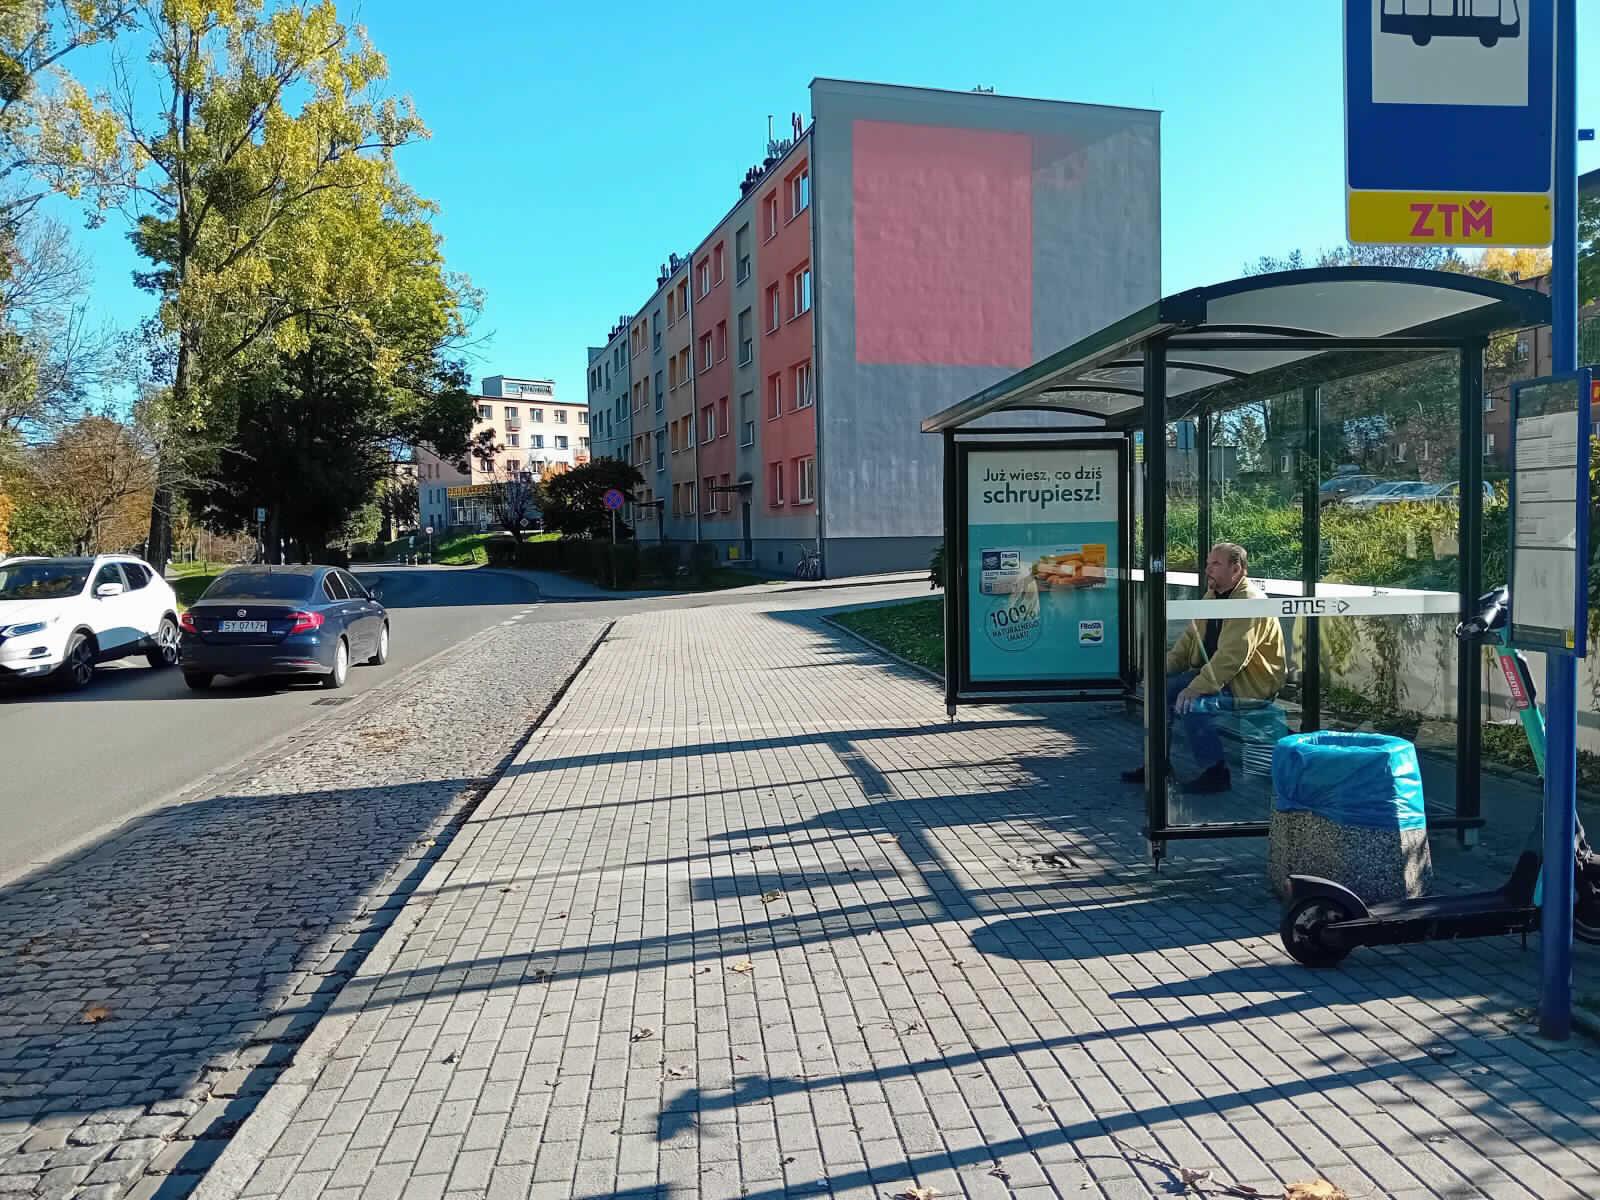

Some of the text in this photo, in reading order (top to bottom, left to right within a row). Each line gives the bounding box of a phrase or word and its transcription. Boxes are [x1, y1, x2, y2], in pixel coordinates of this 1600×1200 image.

[1410, 201, 1492, 238] ZTM
[984, 466, 1103, 482] Już wiesz, co dziś
[983, 481, 1101, 509] schrupiesz!
[990, 604, 1036, 629] 100%
[1281, 600, 1326, 615] ams
